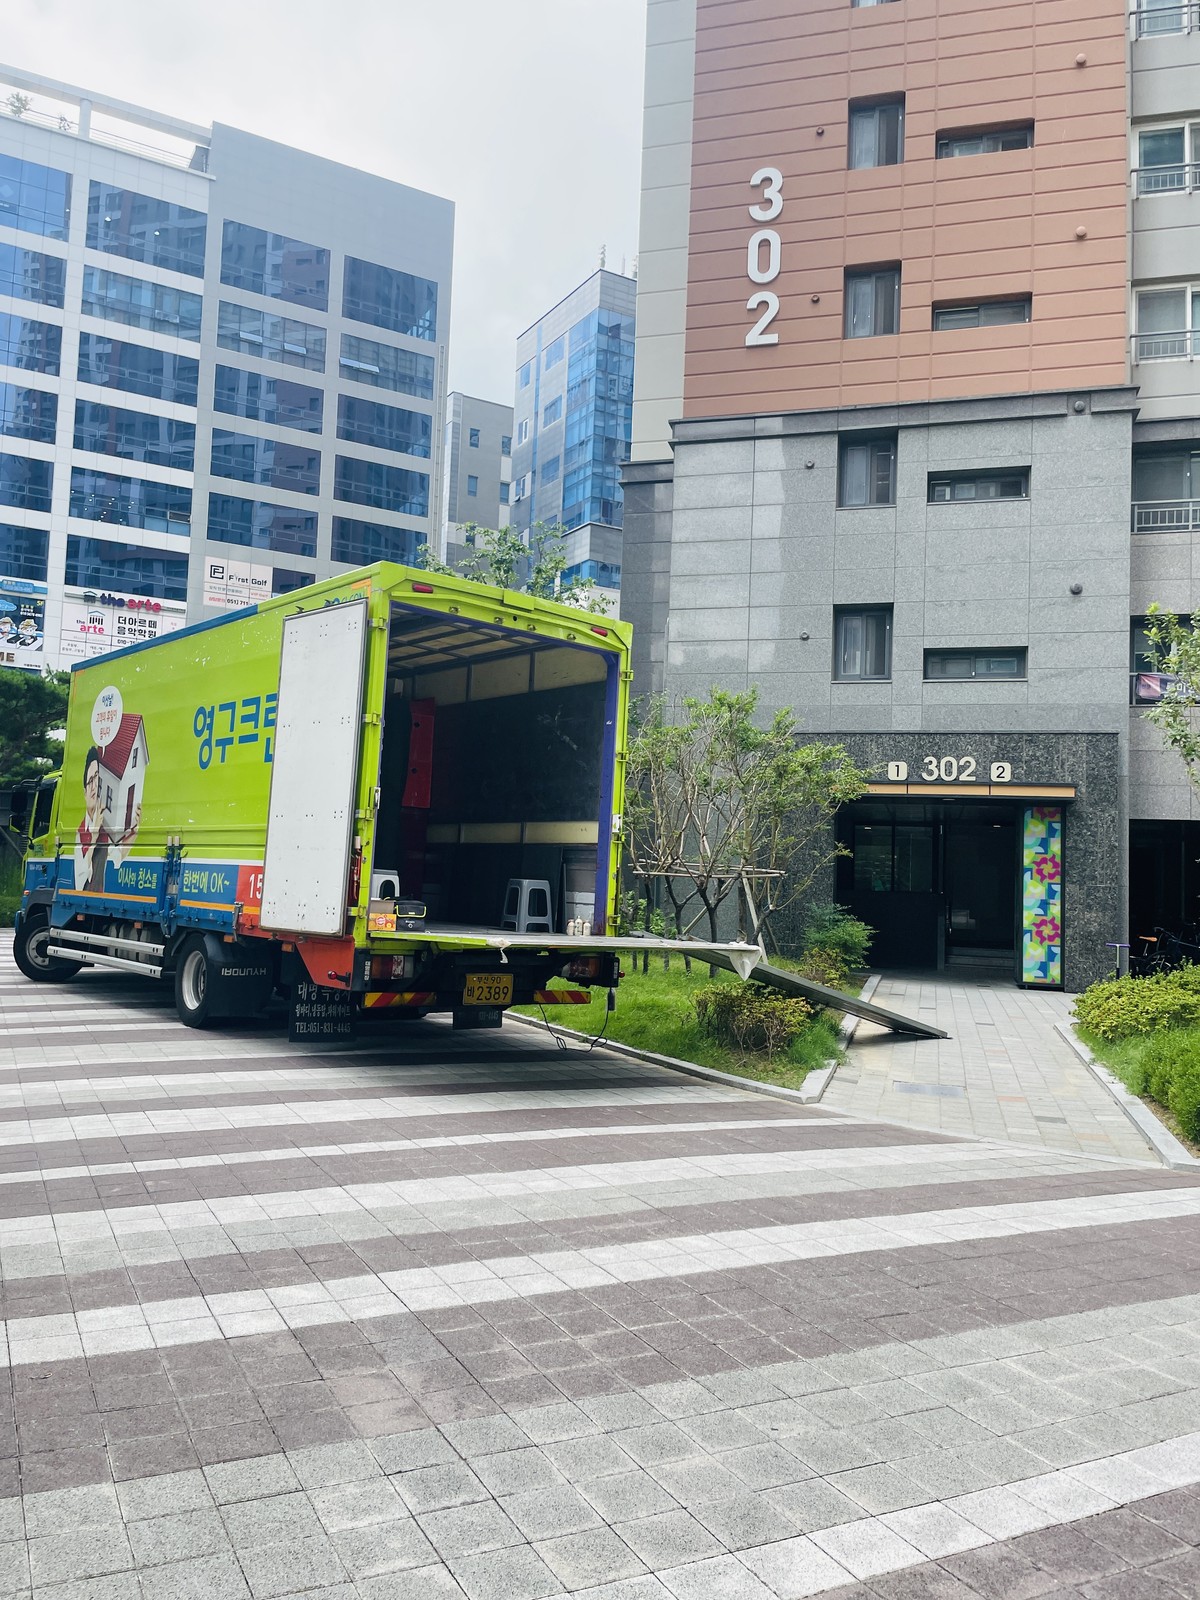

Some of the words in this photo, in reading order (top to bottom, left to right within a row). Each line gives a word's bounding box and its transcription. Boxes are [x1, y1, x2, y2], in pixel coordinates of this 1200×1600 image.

[745, 167, 784, 347] 302
[251, 578, 268, 587] Golf
[100, 592, 126, 607] the
[127, 598, 162, 613] arte
[80, 624, 105, 635] arte
[117, 626, 157, 639] 음악학원
[921, 755, 977, 782] 302
[118, 867, 136, 888] 이사와
[137, 868, 158, 889] 청소를
[183, 870, 209, 894] 한번에
[221, 967, 267, 976] HYUNDAI
